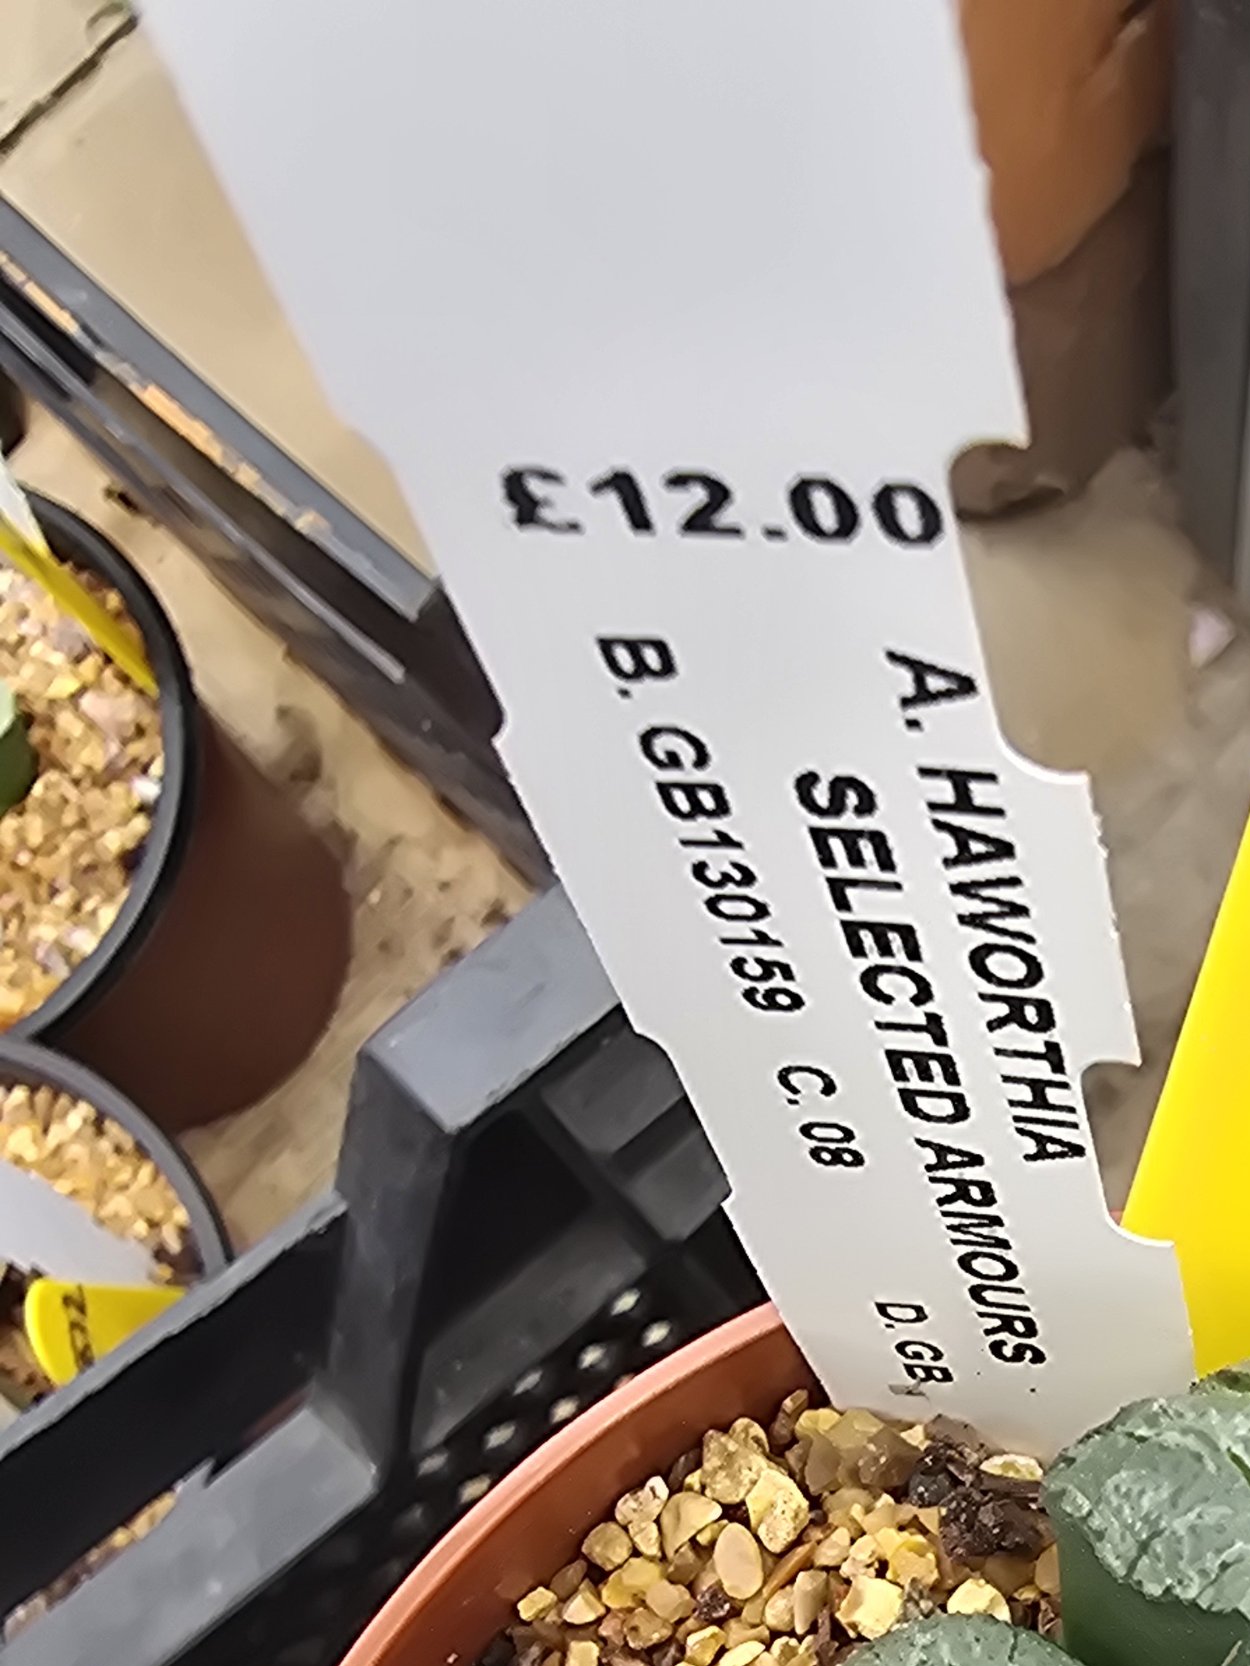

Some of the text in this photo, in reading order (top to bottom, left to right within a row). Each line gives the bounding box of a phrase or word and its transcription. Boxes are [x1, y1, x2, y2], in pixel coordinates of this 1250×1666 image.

[501, 466, 945, 548] £12.00
[595, 636, 954, 1384] B. GB130159 C. 08 D. GB
[793, 770, 1047, 1365] SELECTED ARMOURS
[885, 649, 1086, 1162] A. HAWORTHIA
